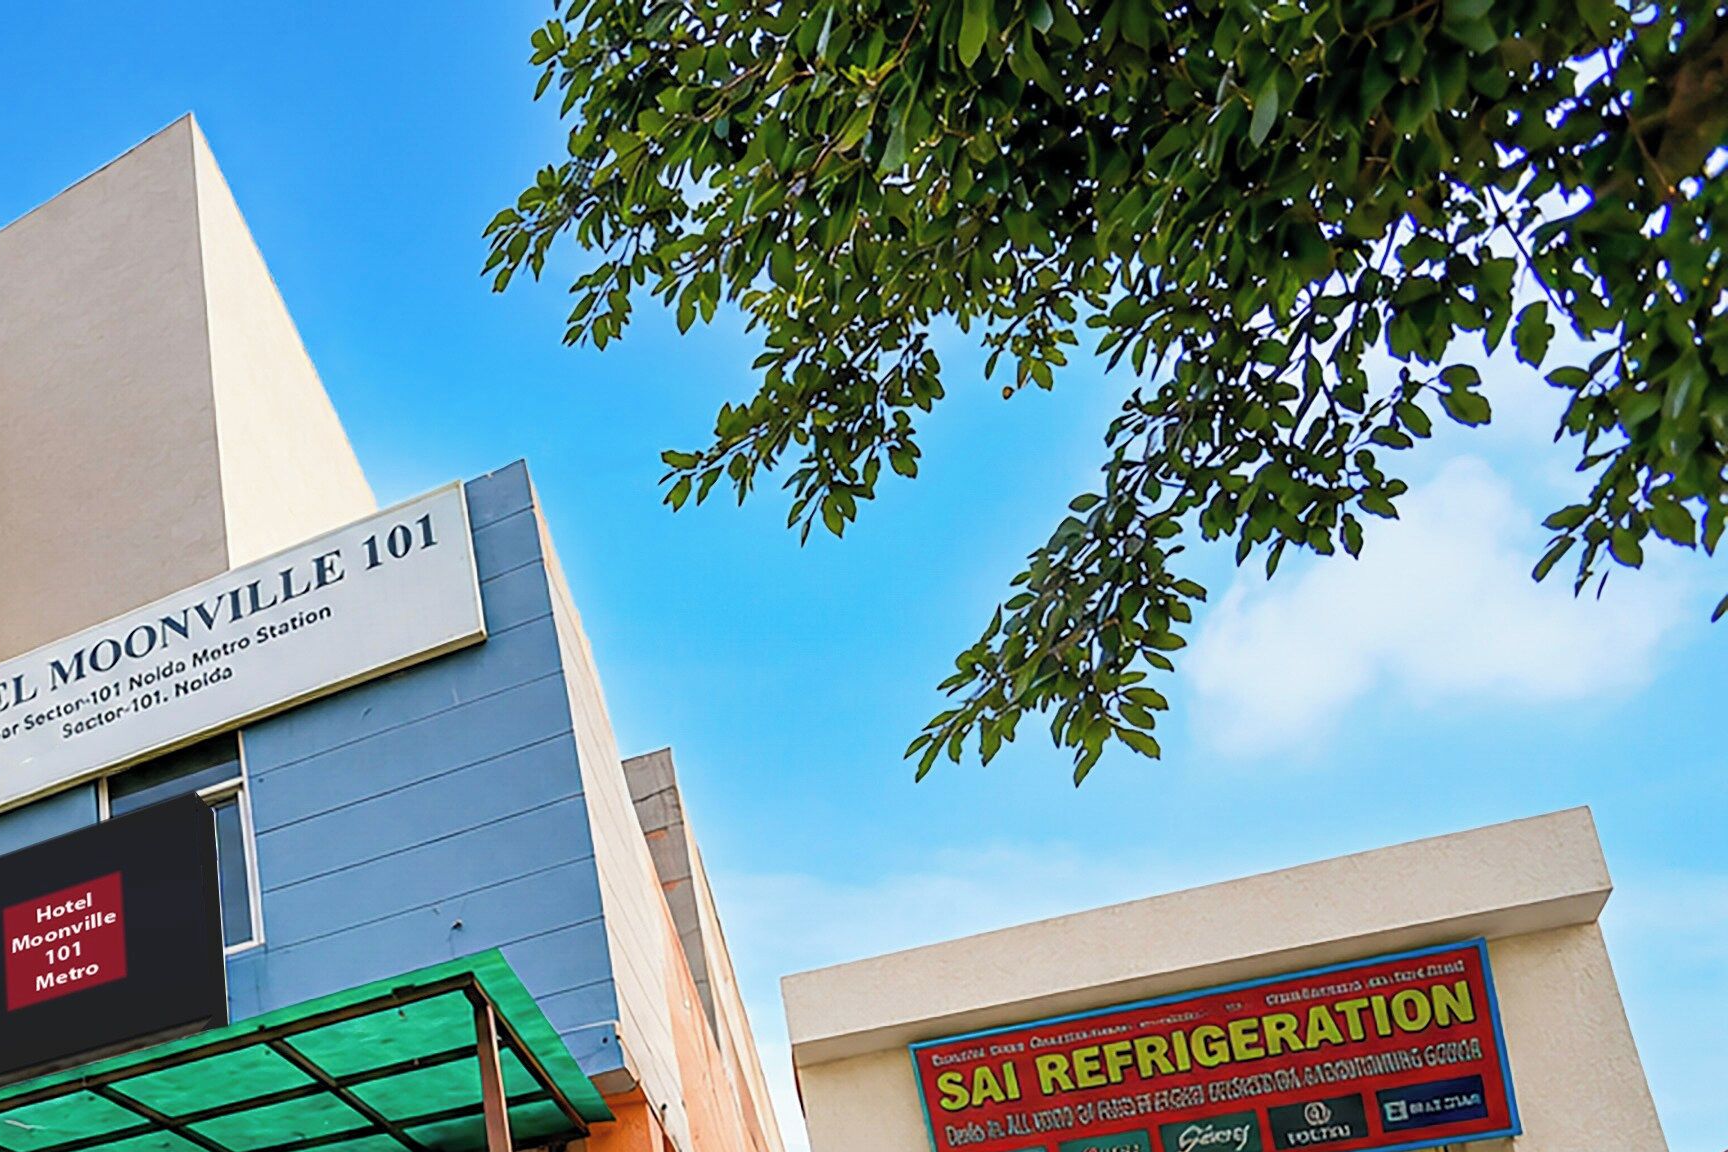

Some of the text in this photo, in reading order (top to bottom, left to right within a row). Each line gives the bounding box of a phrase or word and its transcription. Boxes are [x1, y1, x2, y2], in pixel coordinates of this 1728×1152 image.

[49, 550, 345, 691] MOONVILLE
[362, 513, 438, 570] 101
[129, 660, 186, 692] Noida
[192, 635, 251, 667] Metro
[256, 605, 332, 644] Station
[175, 665, 233, 698] Noida
[36, 892, 92, 923] Hotel
[12, 912, 116, 954] Moonville
[45, 941, 82, 965] 101
[35, 963, 99, 991] Metro
[936, 1060, 1021, 1112] SAI
[1035, 980, 1476, 1096] REFRIGERATION
